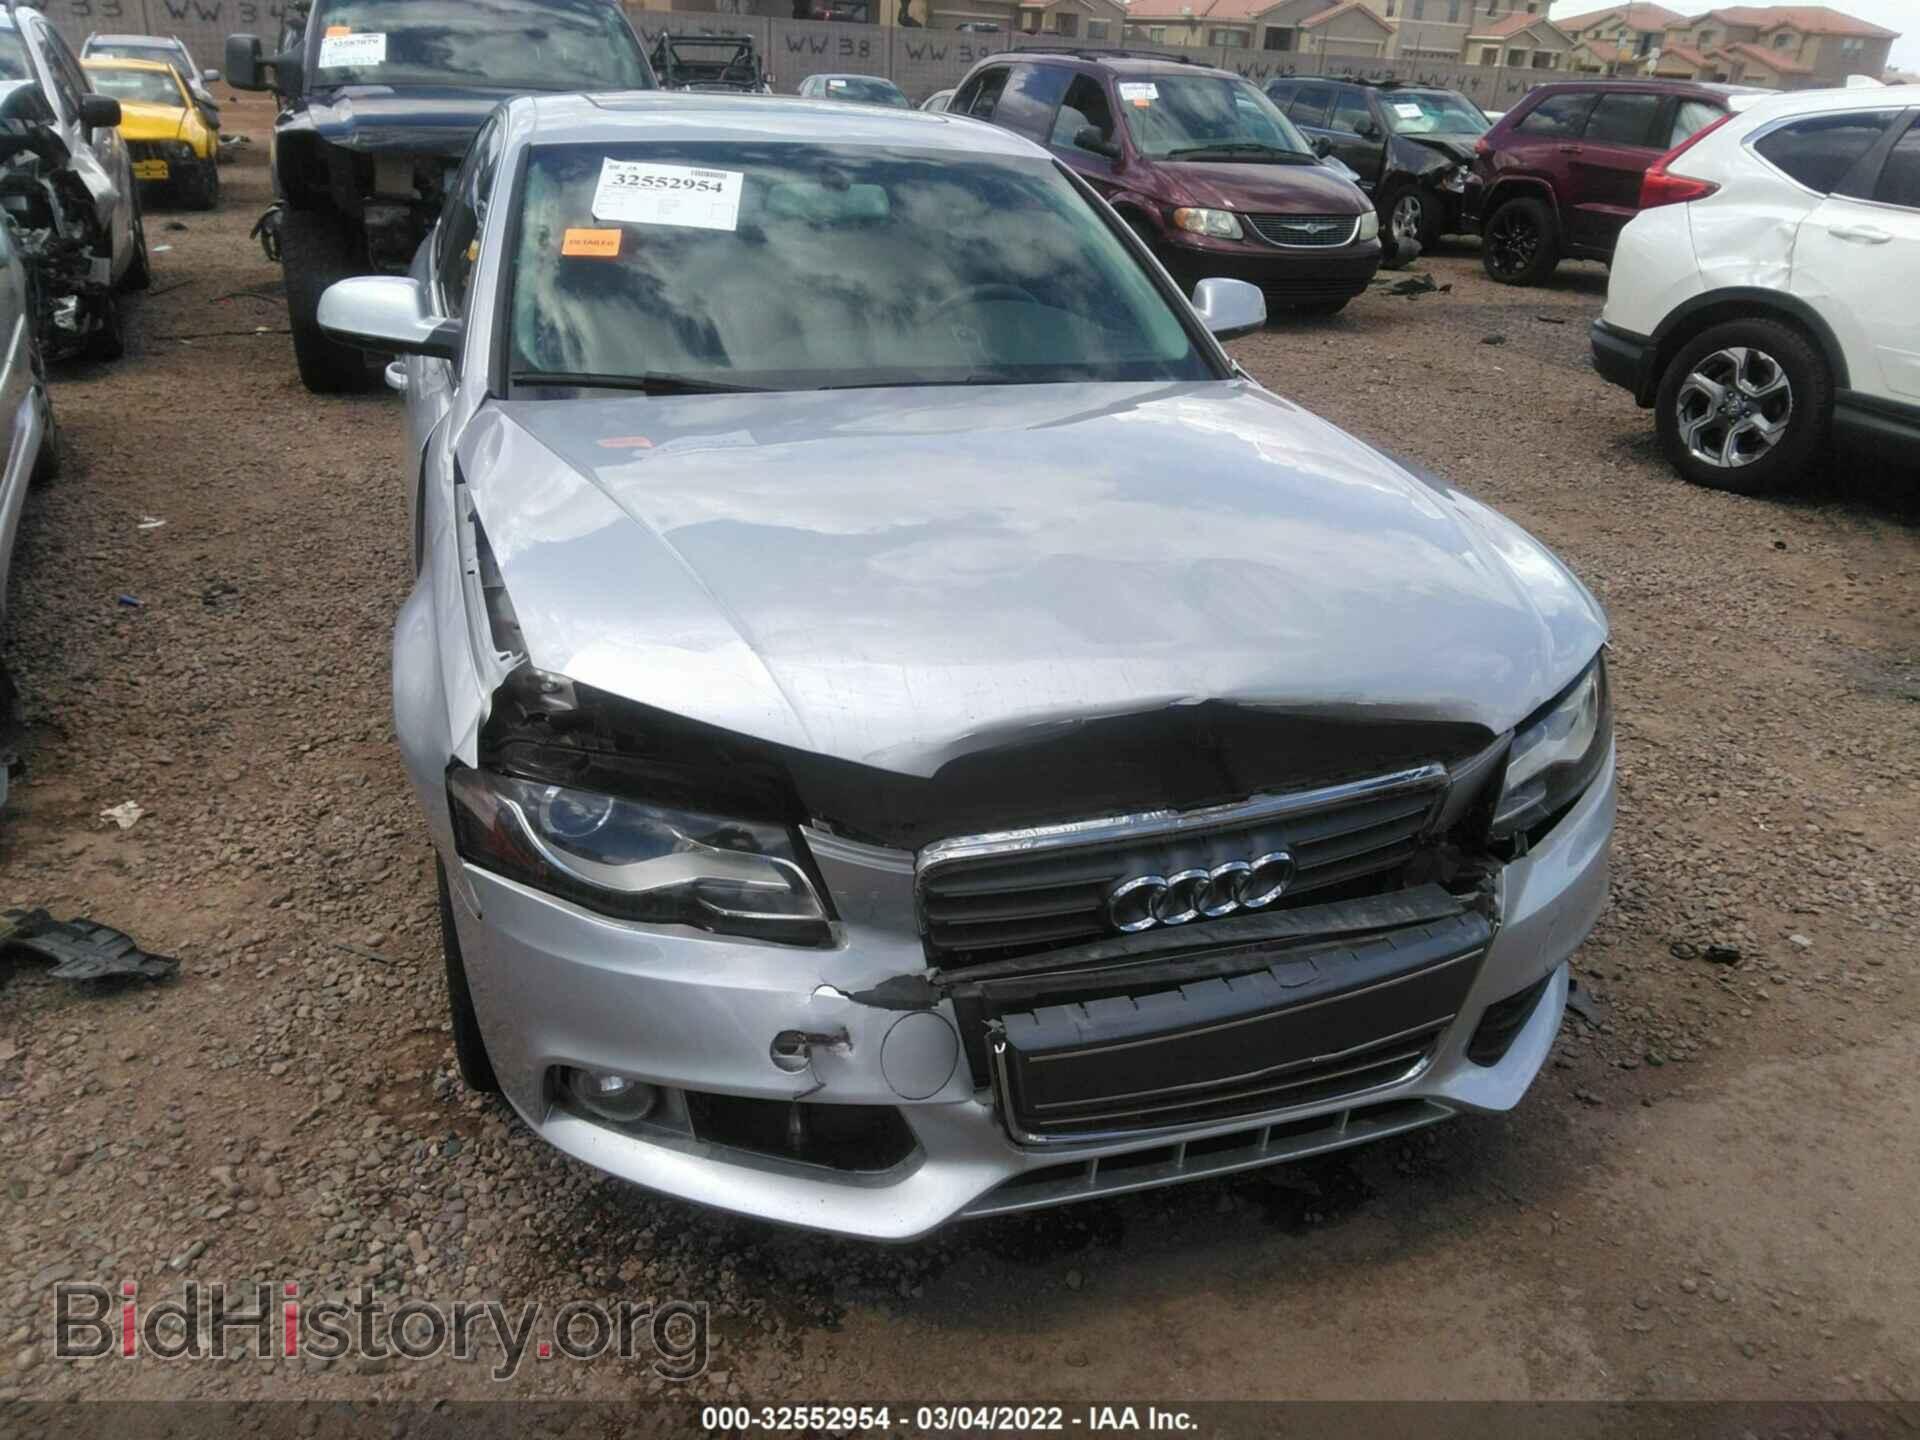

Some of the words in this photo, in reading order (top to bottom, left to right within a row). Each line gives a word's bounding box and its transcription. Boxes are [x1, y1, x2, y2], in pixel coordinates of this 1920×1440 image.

[162, 0, 223, 22] WW
[786, 34, 829, 55] WW
[838, 37, 871, 59] 38
[905, 41, 948, 62] WW
[612, 174, 723, 194] 32552954
